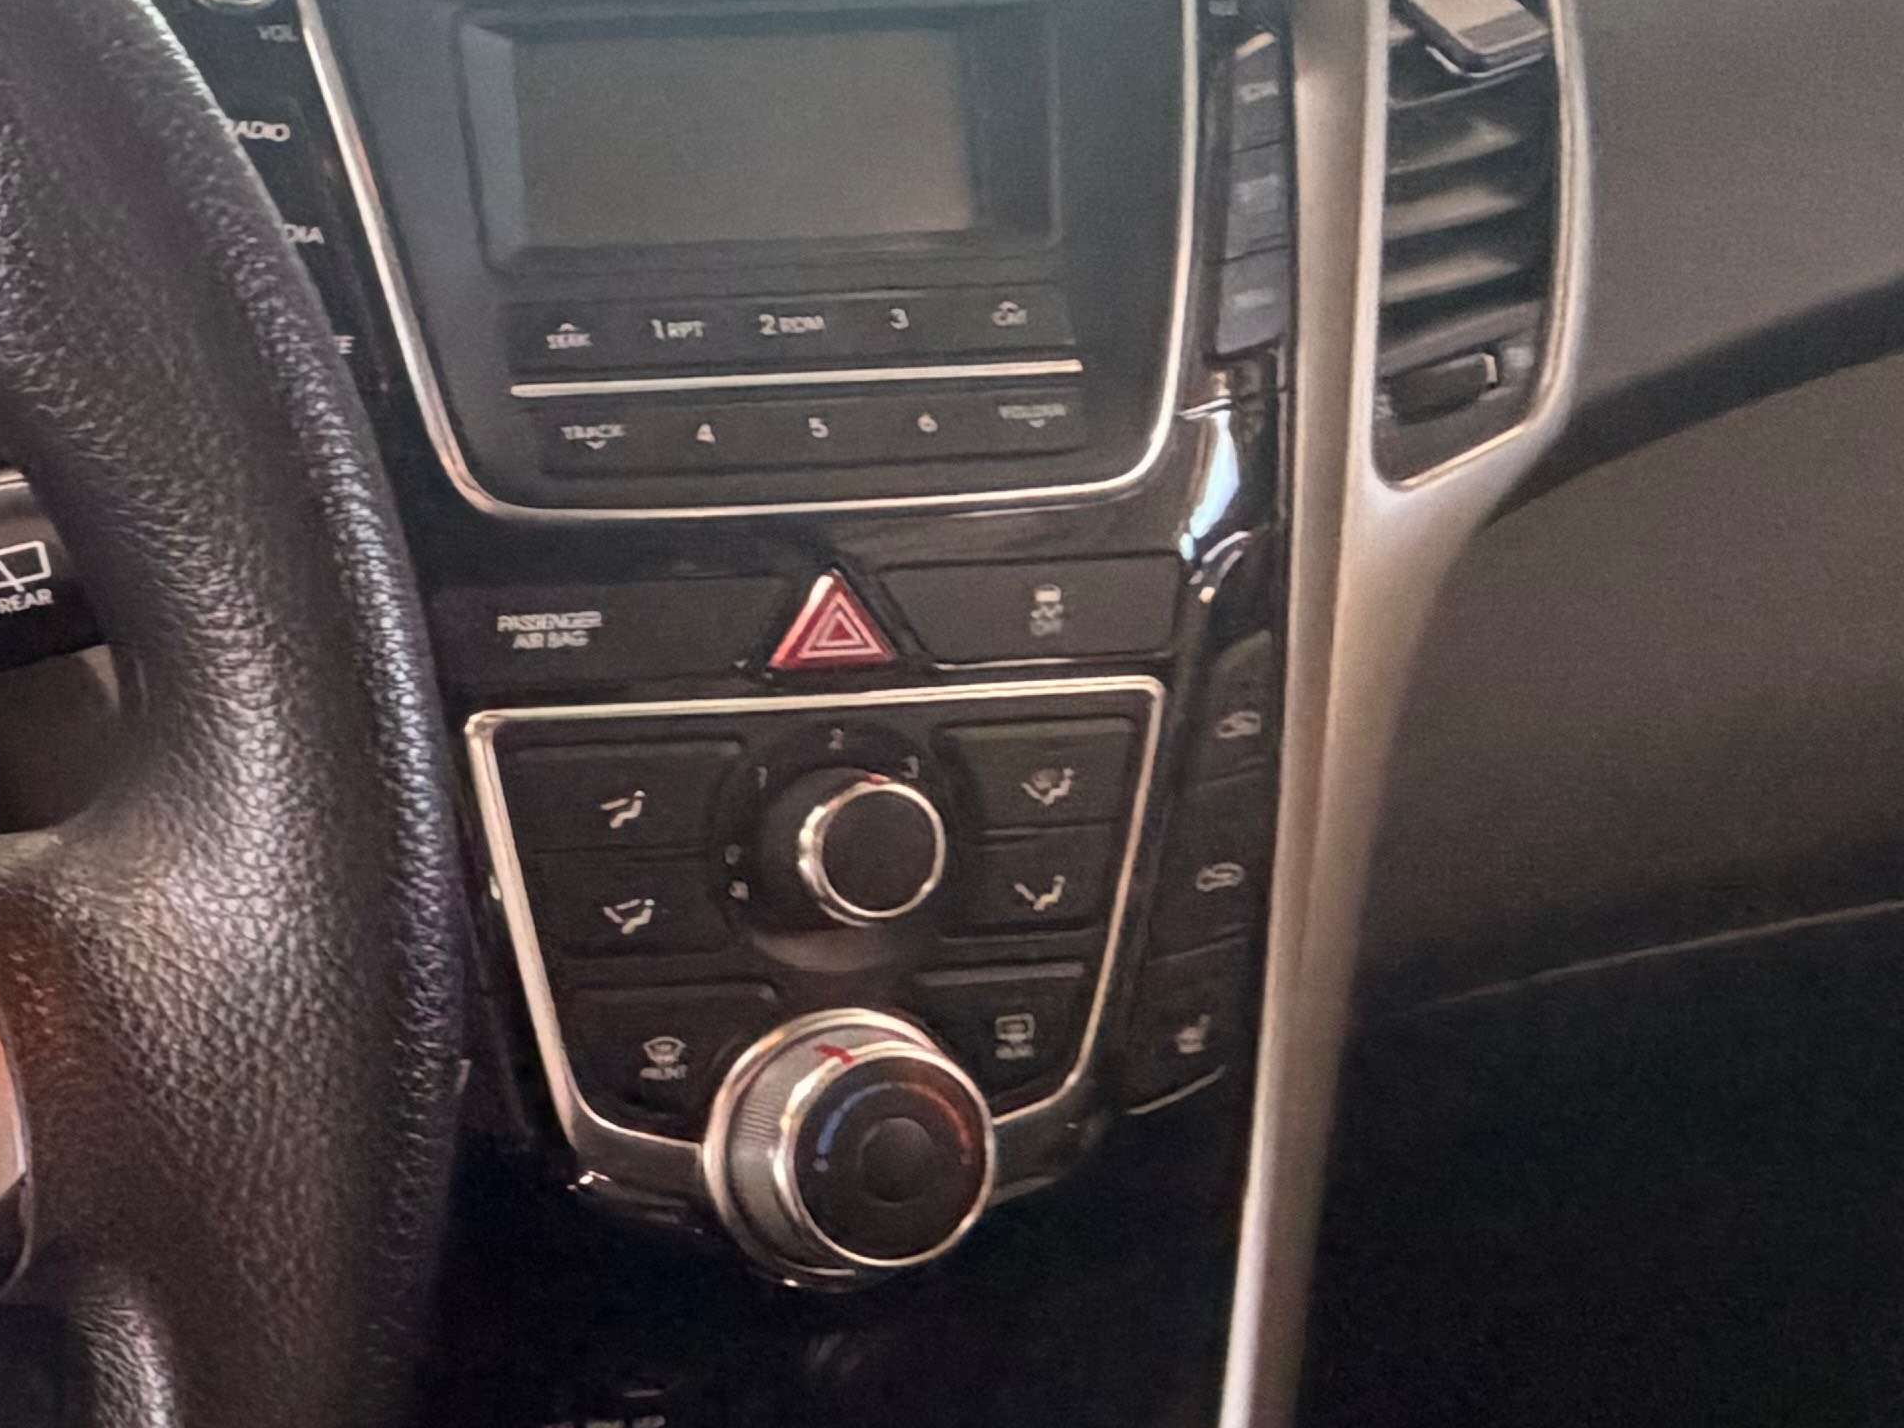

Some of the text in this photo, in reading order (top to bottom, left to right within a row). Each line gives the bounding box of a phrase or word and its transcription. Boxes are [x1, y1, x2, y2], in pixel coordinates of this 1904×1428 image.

[257, 24, 298, 43] VOL
[282, 223, 325, 244] DIA
[891, 308, 909, 330] 3
[808, 417, 829, 438] 5
[917, 413, 938, 433] 6
[496, 610, 603, 632] PASSENGER
